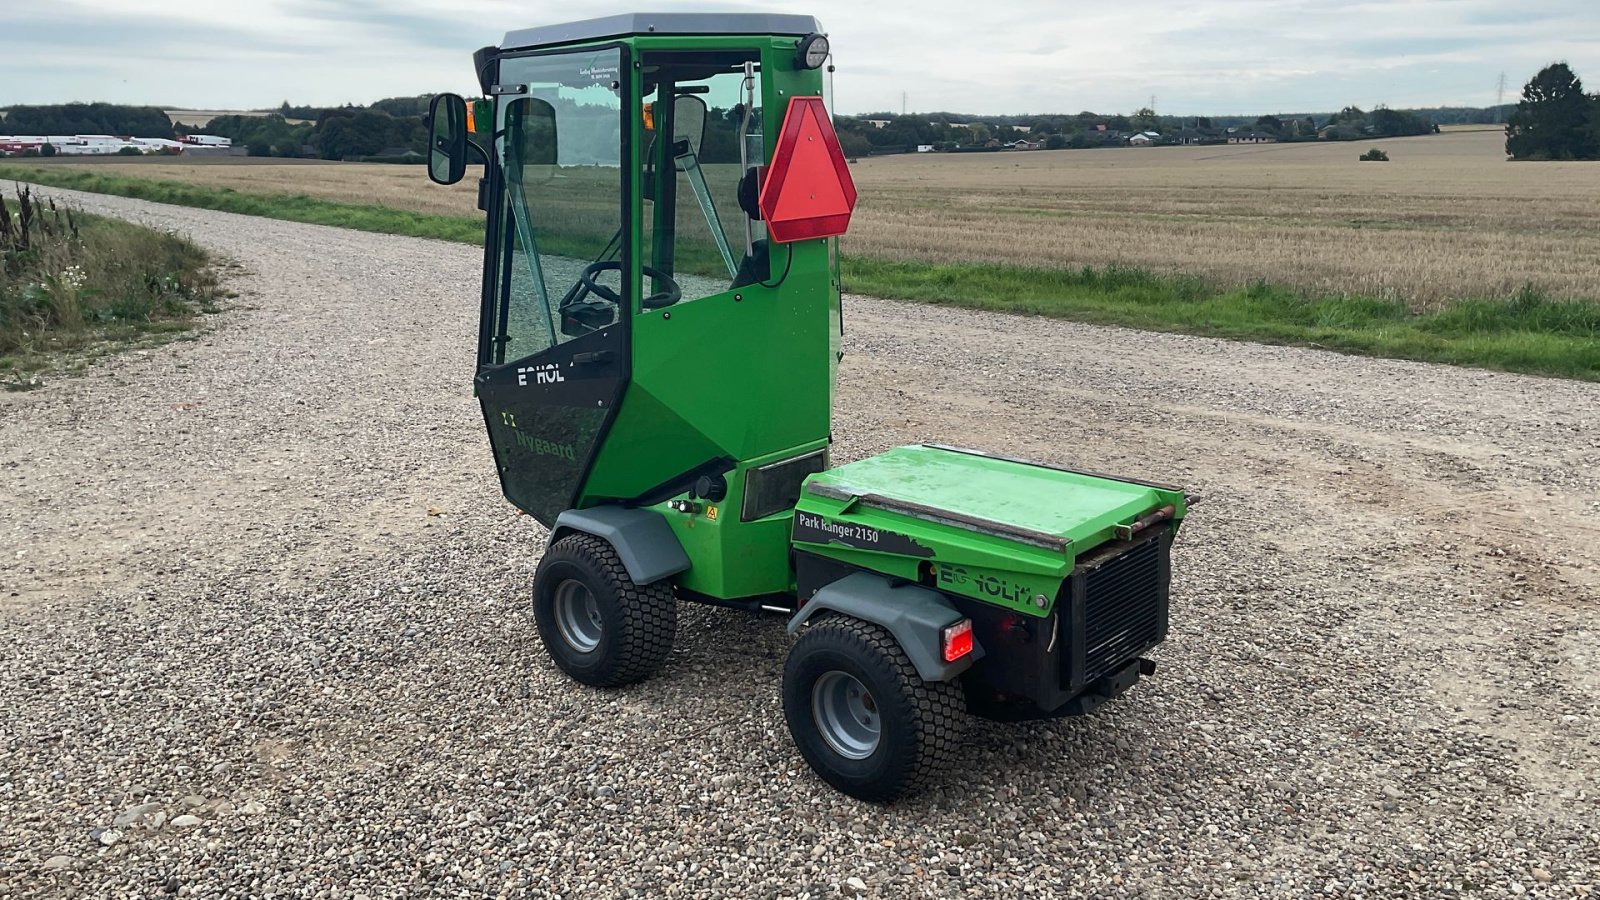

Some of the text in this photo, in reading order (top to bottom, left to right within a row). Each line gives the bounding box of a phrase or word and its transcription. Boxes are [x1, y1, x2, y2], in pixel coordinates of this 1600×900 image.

[515, 430, 576, 461] Nygaard
[800, 513, 819, 529] Park
[855, 526, 879, 543] 2150
